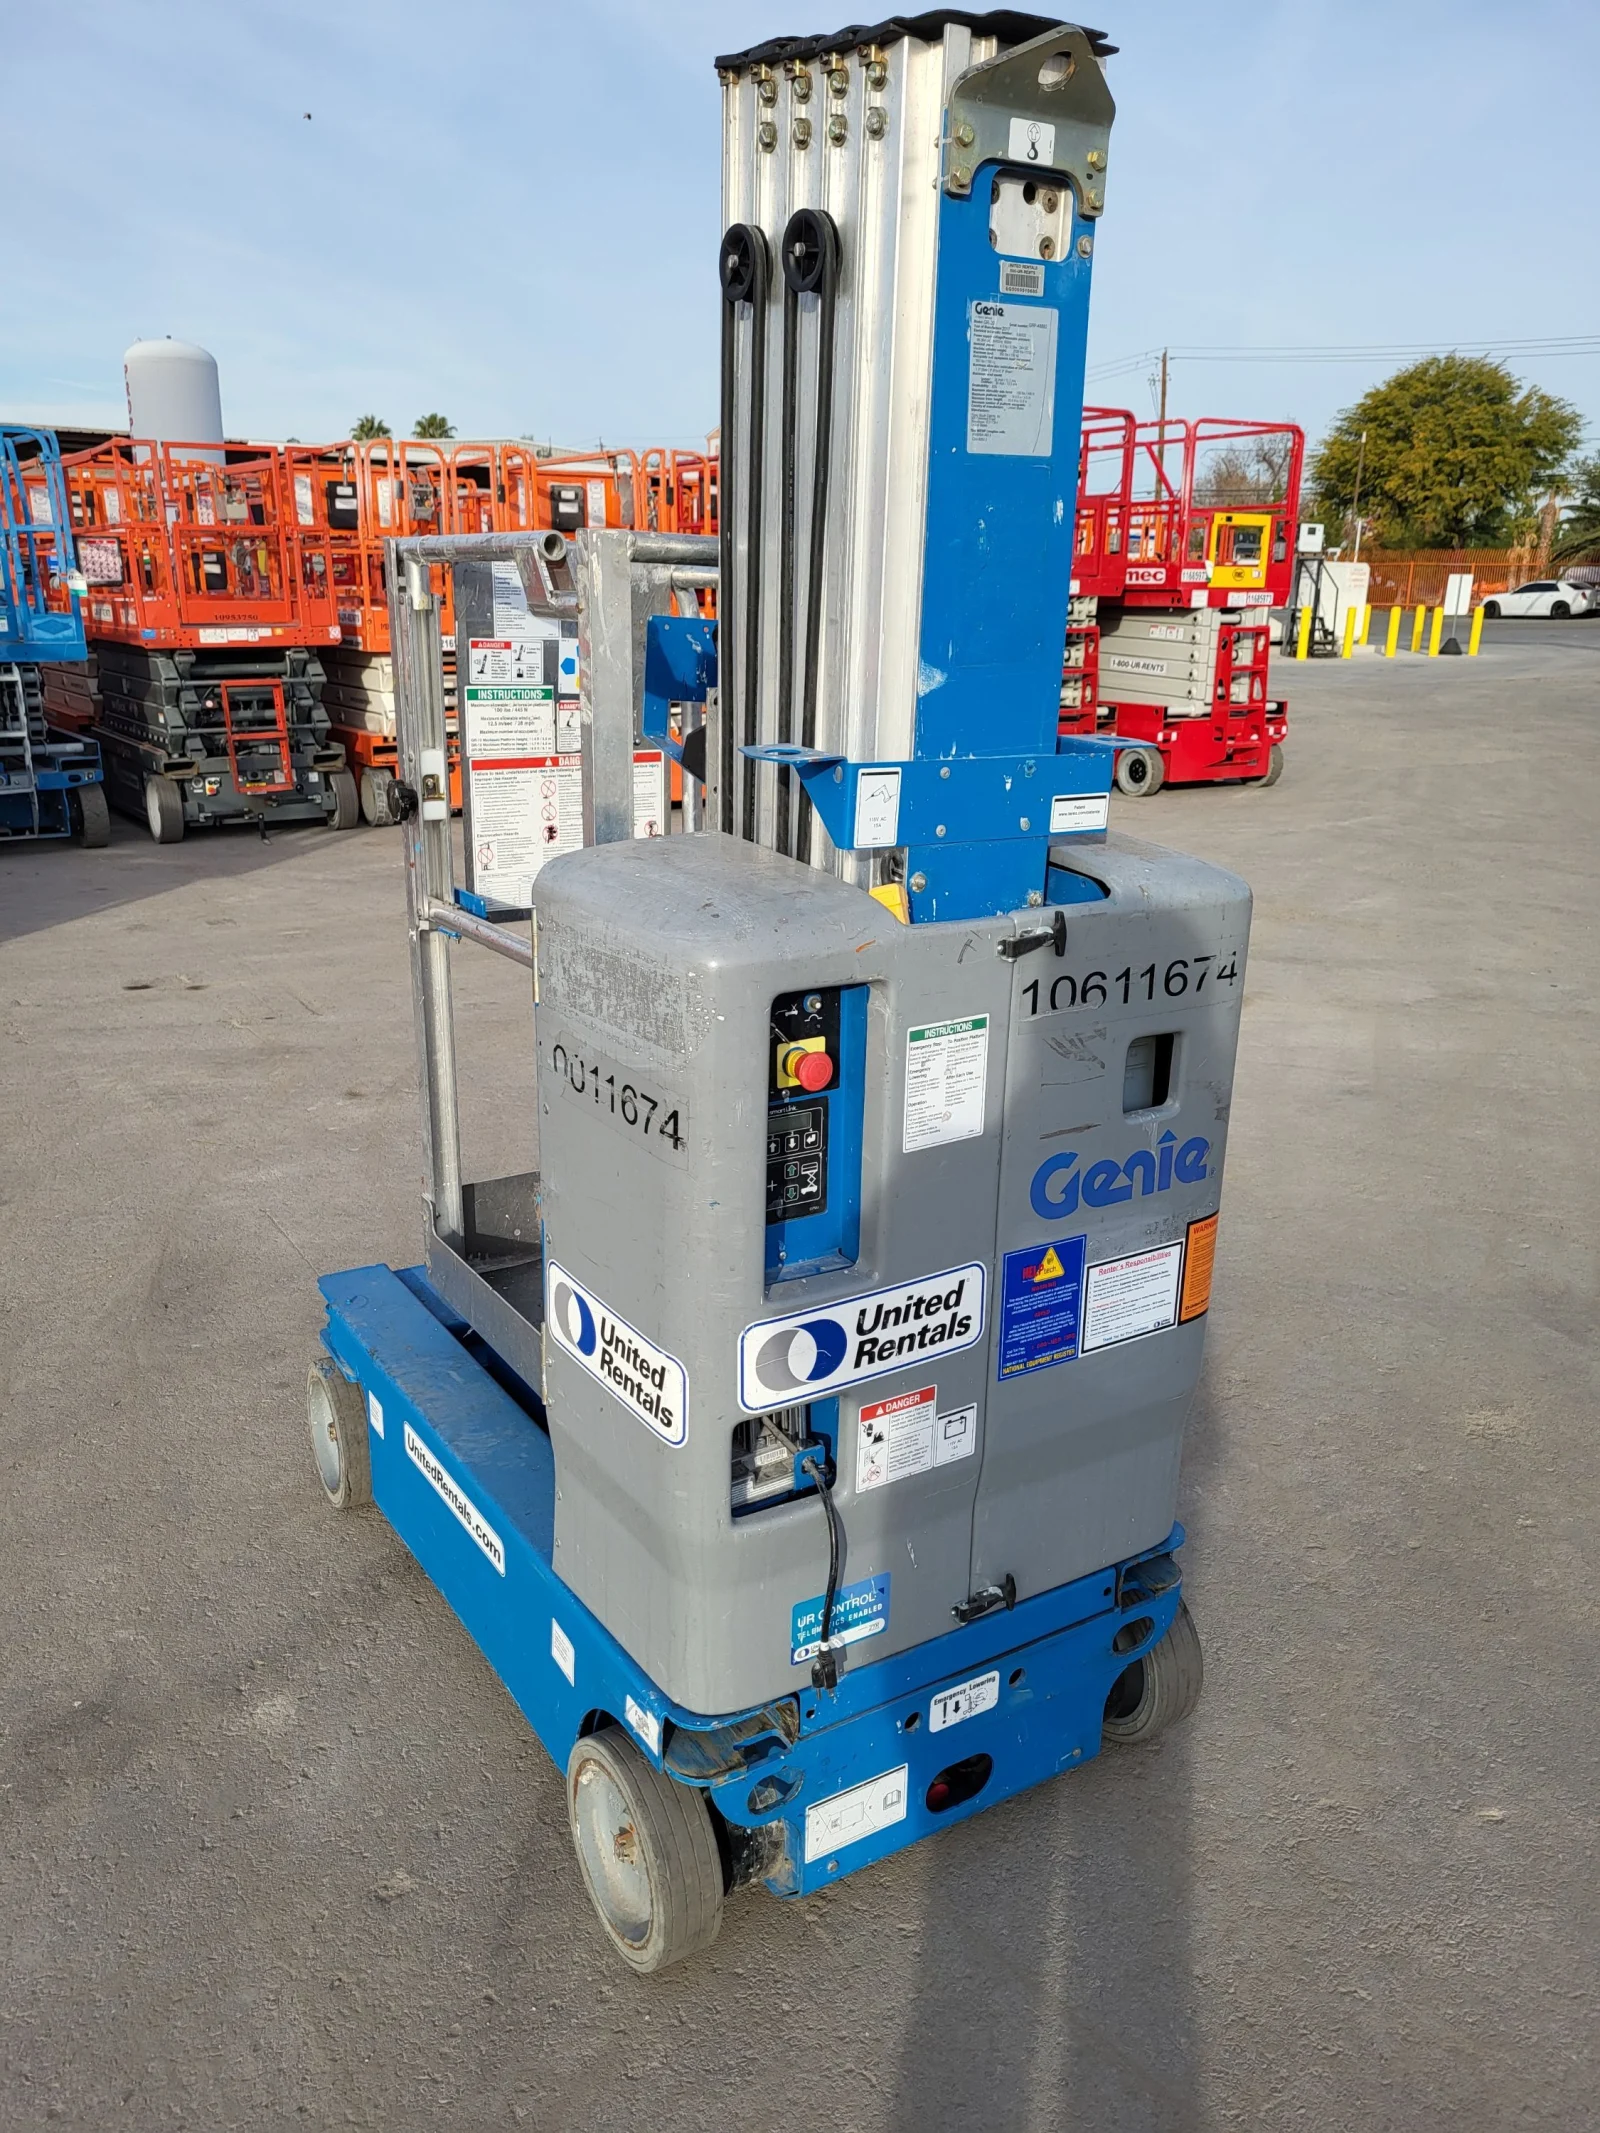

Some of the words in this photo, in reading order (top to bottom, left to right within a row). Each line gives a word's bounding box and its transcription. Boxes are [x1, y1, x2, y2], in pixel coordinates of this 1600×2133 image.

[975, 302, 1004, 317] Genie
[478, 689, 542, 700] INSTRUCTIONS
[1022, 951, 1238, 1016] 10611674
[924, 1021, 973, 1039] INSTRUCTIONS
[1022, 1263, 1045, 1280] HELP
[1098, 1264, 1124, 1276] Renter's
[1124, 1250, 1172, 1269] Responsibilities
[856, 1279, 966, 1337] United
[853, 1311, 973, 1370] Rentals
[600, 1316, 666, 1392] United
[1002, 1363, 1025, 1375] NATIONAL
[1026, 1354, 1053, 1368] EQUIPMENT
[1053, 1349, 1075, 1360] REGISTER
[600, 1347, 674, 1429] Rentals
[885, 1394, 921, 1413] DANGER
[407, 1432, 501, 1563] UnitedRentals.com
[797, 1613, 815, 1628] UR
[848, 1603, 883, 1622] ENABLED
[934, 1688, 967, 1706] Emergency
[969, 1676, 996, 1691] Lowering
